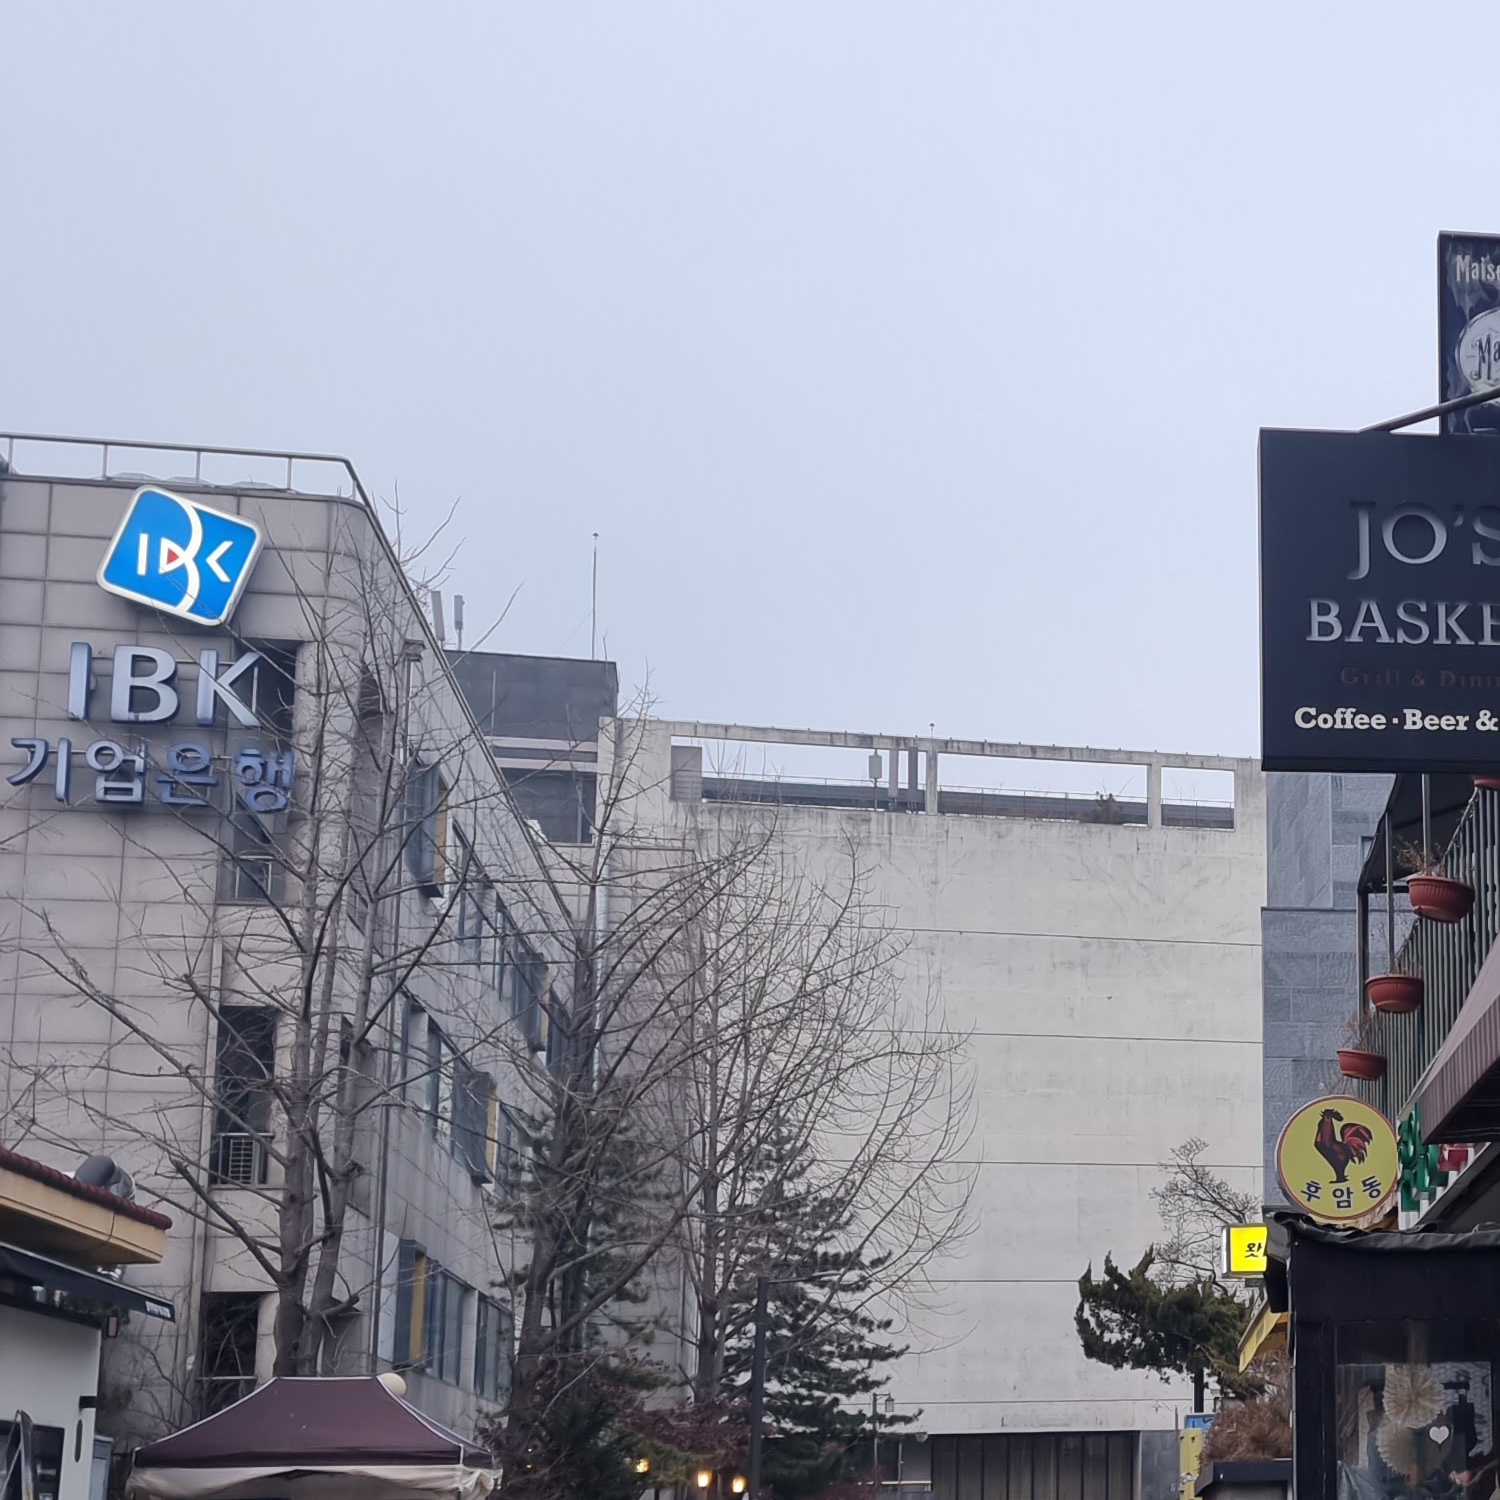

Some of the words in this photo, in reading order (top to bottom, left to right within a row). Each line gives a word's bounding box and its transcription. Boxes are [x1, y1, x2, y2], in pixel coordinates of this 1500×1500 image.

[67, 641, 263, 728] IBK
[1340, 666, 1400, 687] Grill
[1294, 706, 1387, 730] Coffee
[1403, 708, 1469, 731] Beer
[1475, 709, 1499, 732] &
[6, 737, 297, 813] 기업은행
[1300, 1175, 1382, 1209] 후암동
